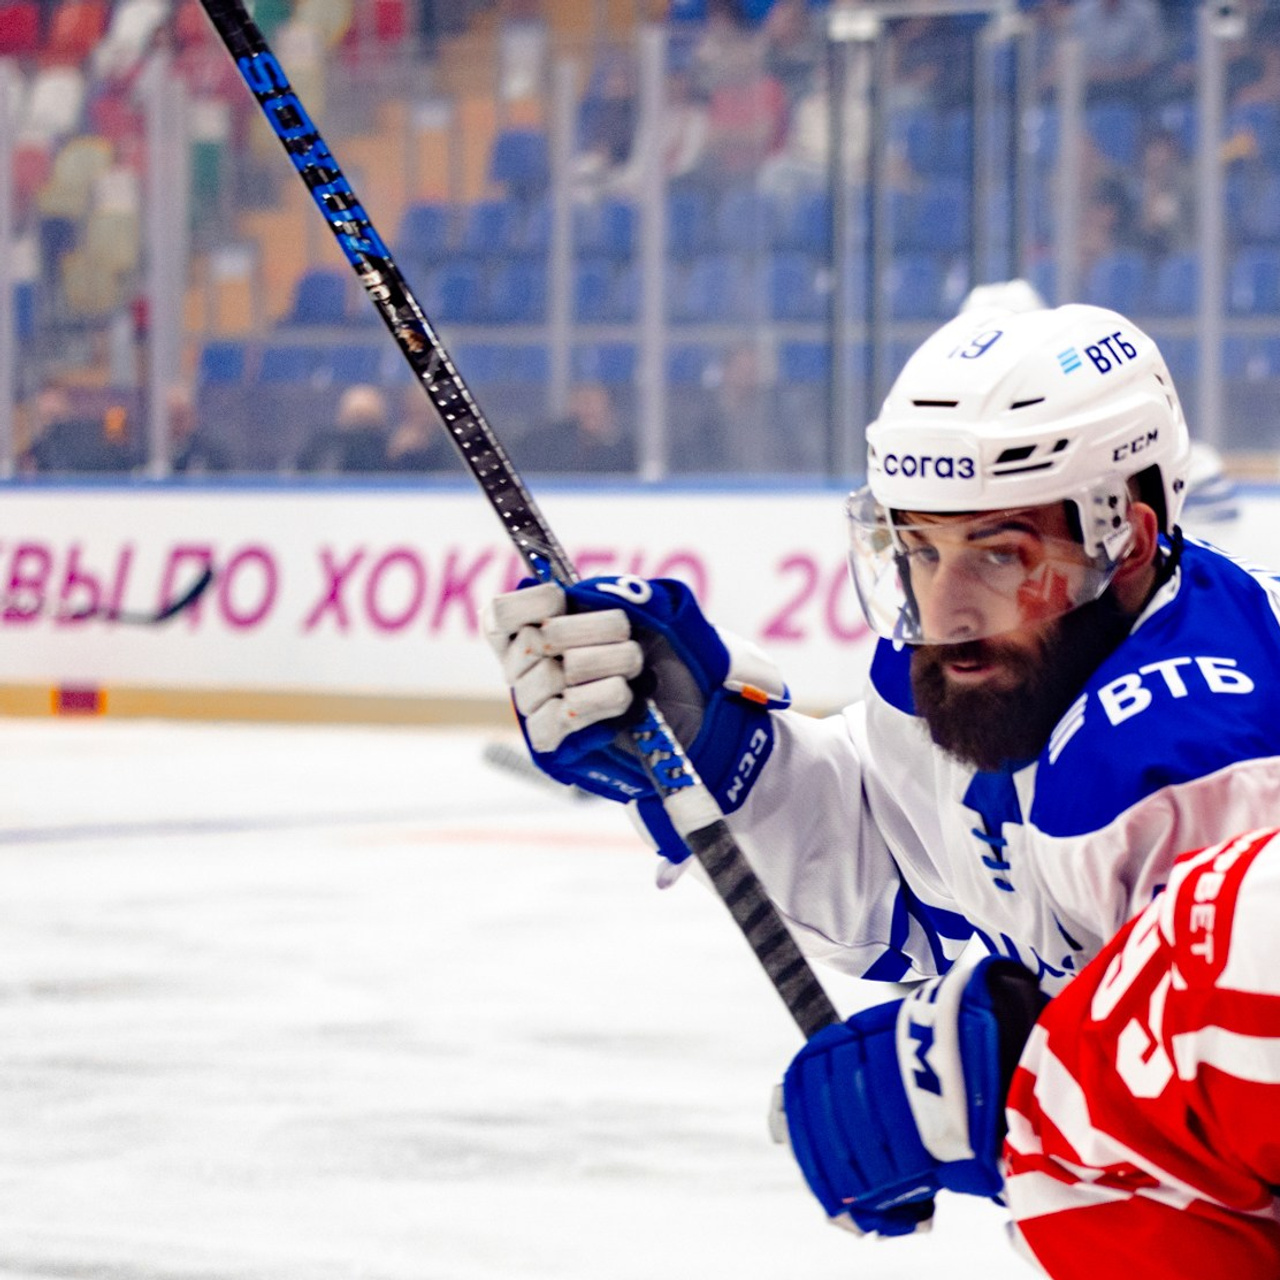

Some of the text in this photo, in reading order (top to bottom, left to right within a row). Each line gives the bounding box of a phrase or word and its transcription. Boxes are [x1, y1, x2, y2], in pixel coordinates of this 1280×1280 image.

[1085, 332, 1137, 374] ВТБ
[1113, 430, 1158, 462] CCM
[0, 540, 137, 630] ВЫ
[153, 541, 282, 632] ПО
[1097, 656, 1255, 727] ВТБ
[727, 728, 768, 803] CCM
